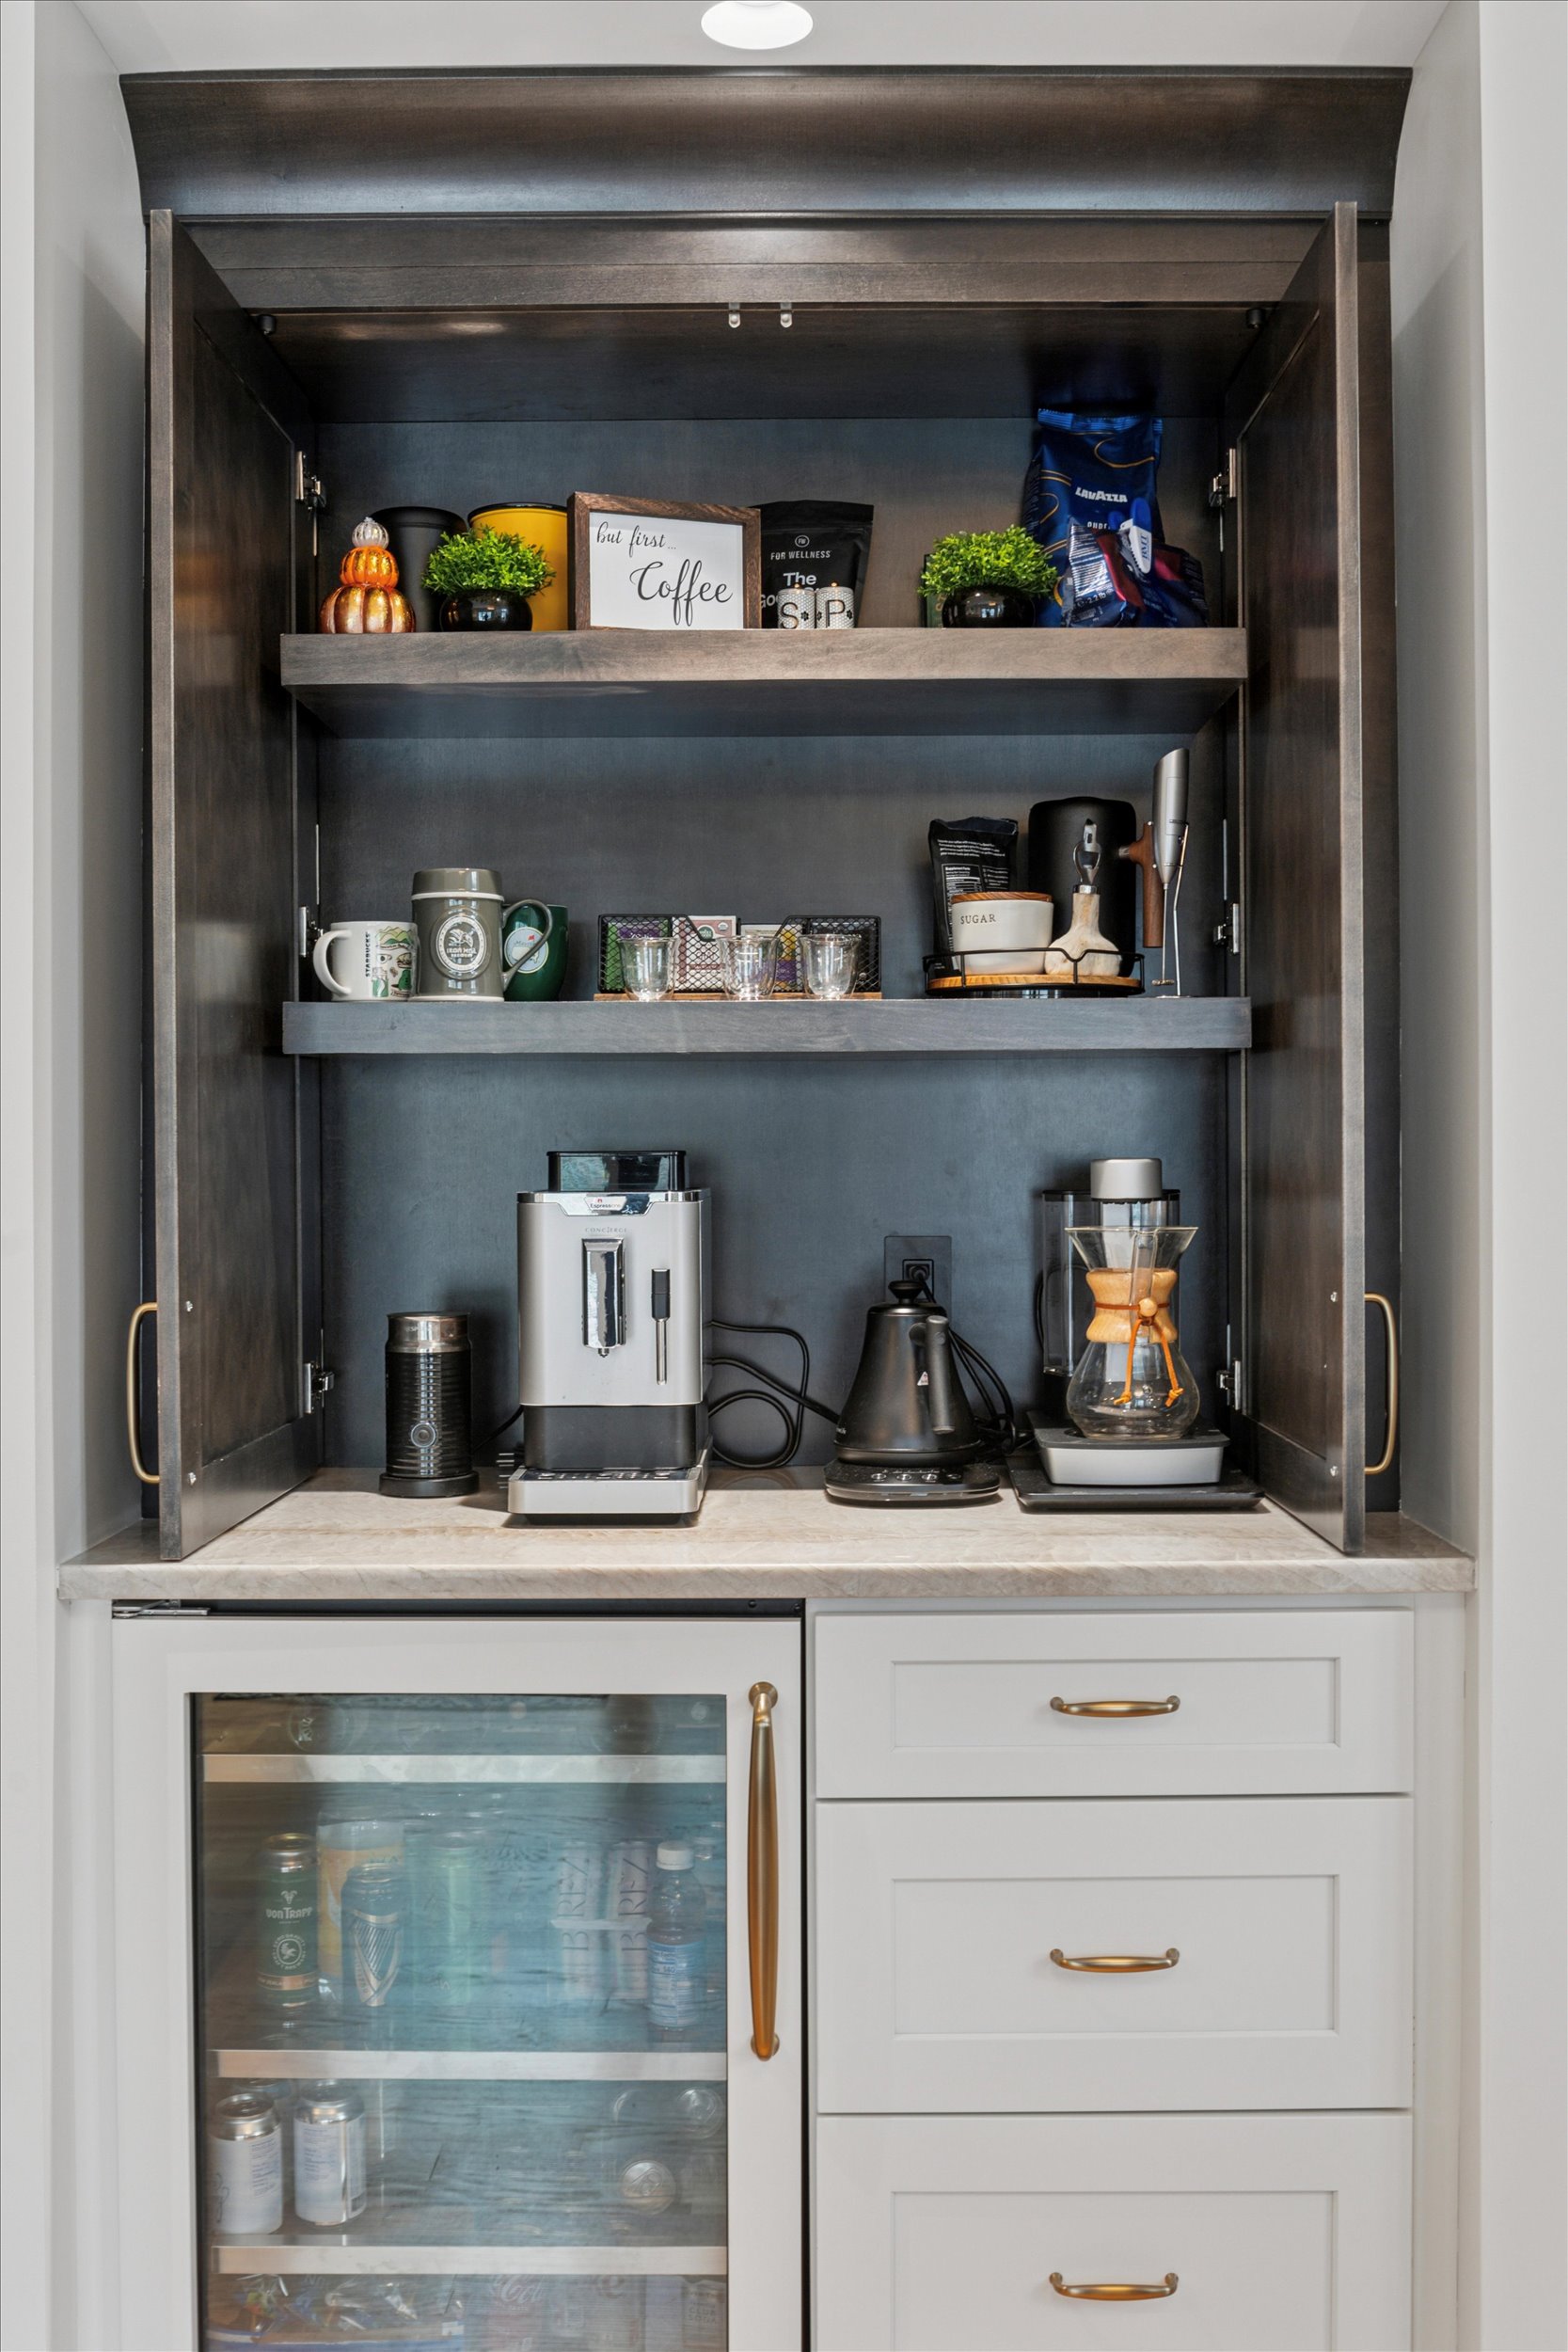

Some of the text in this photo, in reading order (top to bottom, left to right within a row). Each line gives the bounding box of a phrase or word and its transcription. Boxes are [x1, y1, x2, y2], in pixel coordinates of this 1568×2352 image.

[1075, 486, 1128, 502] LAVAZZA
[596, 521, 623, 545] but
[770, 549, 832, 561] FOR WELLNESS
[783, 571, 817, 586] The
[629, 559, 733, 627] Coffee
[780, 601, 800, 629] S
[825, 599, 846, 628] P
[960, 914, 997, 925] SUGAR
